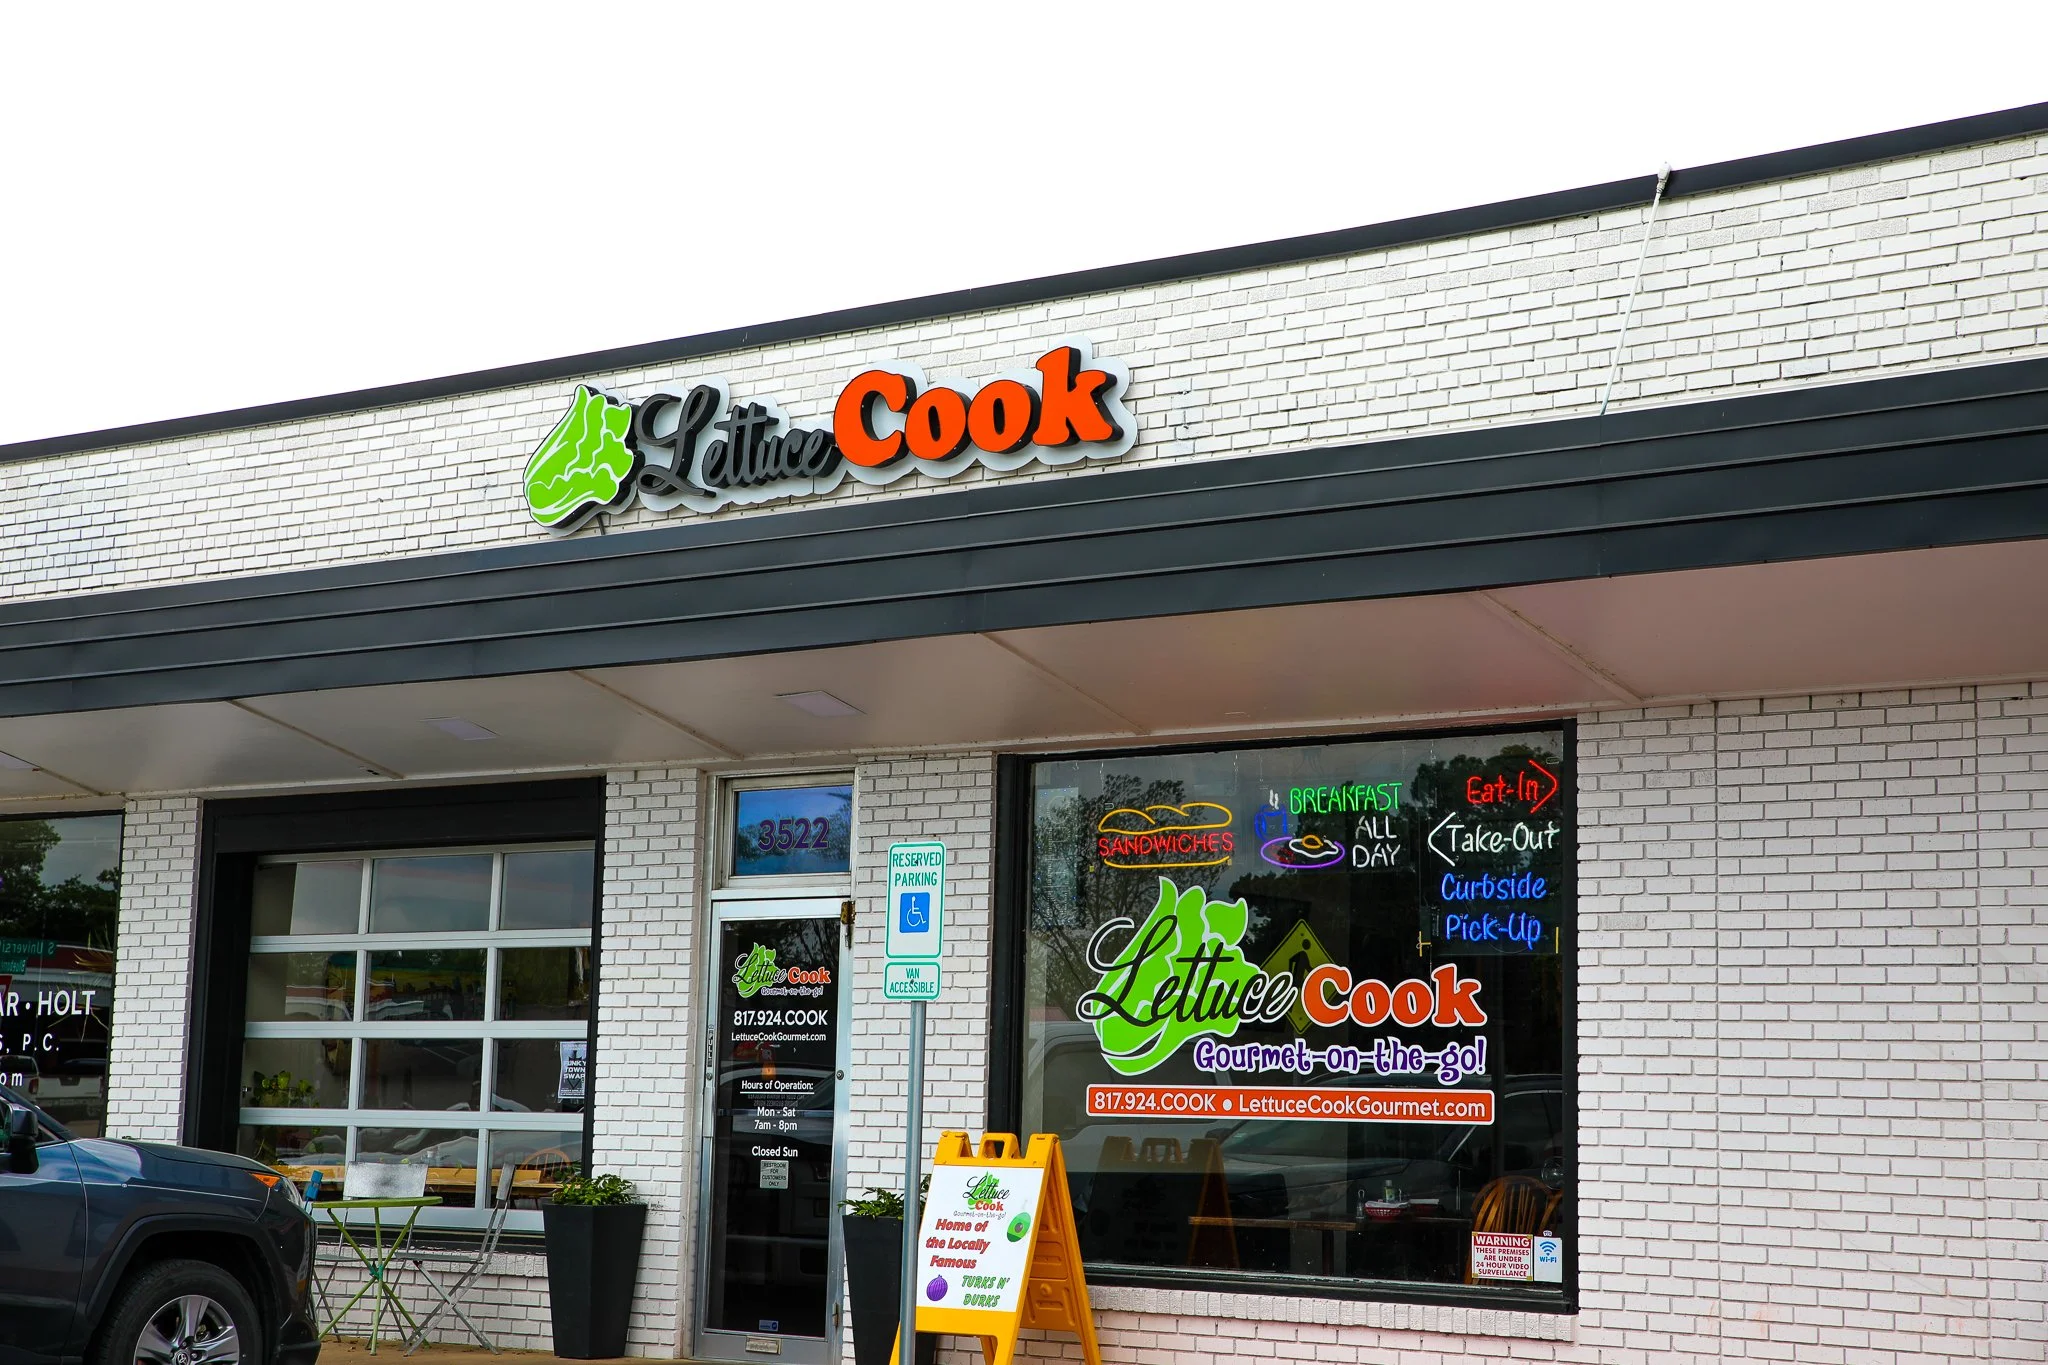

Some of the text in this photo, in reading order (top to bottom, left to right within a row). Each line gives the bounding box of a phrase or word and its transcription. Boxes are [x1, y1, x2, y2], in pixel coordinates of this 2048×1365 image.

[635, 346, 1121, 498] Lettuce Cook
[1466, 771, 1539, 804] Eat-In
[1290, 783, 1403, 815] BREAKFAST
[758, 817, 830, 851] 3522
[1355, 816, 1398, 839] ALL
[1098, 832, 1233, 857] SANDWICHES
[1446, 821, 1560, 853] Take-Out
[892, 852, 941, 868] RESERVED
[1352, 843, 1401, 868] DAY
[895, 872, 938, 887] PARKING
[1441, 872, 1547, 901] Curbside
[1446, 912, 1542, 950] Pick-Up
[732, 953, 832, 985] Lettuce Cook
[906, 968, 920, 979] VAN
[1078, 915, 1488, 1029] Lettuce Cook
[890, 982, 935, 993] ACCESSIBLE
[37, 990, 96, 1016] HOLT
[734, 1010, 828, 1026] 817.924.COOK
[731, 1032, 827, 1041] LettuceCookGourmet.com
[1194, 1037, 1488, 1086] Gourmet-on-the-go!
[741, 1080, 813, 1091] Hours of Operation:
[757, 1106, 775, 1117] Mon
[782, 1106, 796, 1117] Sat
[1094, 1092, 1486, 1118] 817.924.COOK LettuceCookGourmet.com
[754, 1119, 771, 1130] 7am
[779, 1120, 798, 1132] 8pm
[752, 1146, 798, 1157] Closed Sun
[962, 1176, 1010, 1200] Lettuce
[975, 1200, 1004, 1211] Cook
[935, 1219, 989, 1232] Home of
[926, 1237, 991, 1254] the Locally
[1475, 1235, 1530, 1247] WARNING
[1498, 1248, 1530, 1256] PREMISES
[930, 1255, 978, 1269] Famous
[1478, 1269, 1527, 1277] SURVEILLANCE
[961, 1275, 997, 1289] TURKS
[963, 1293, 1000, 1307] DURKS
